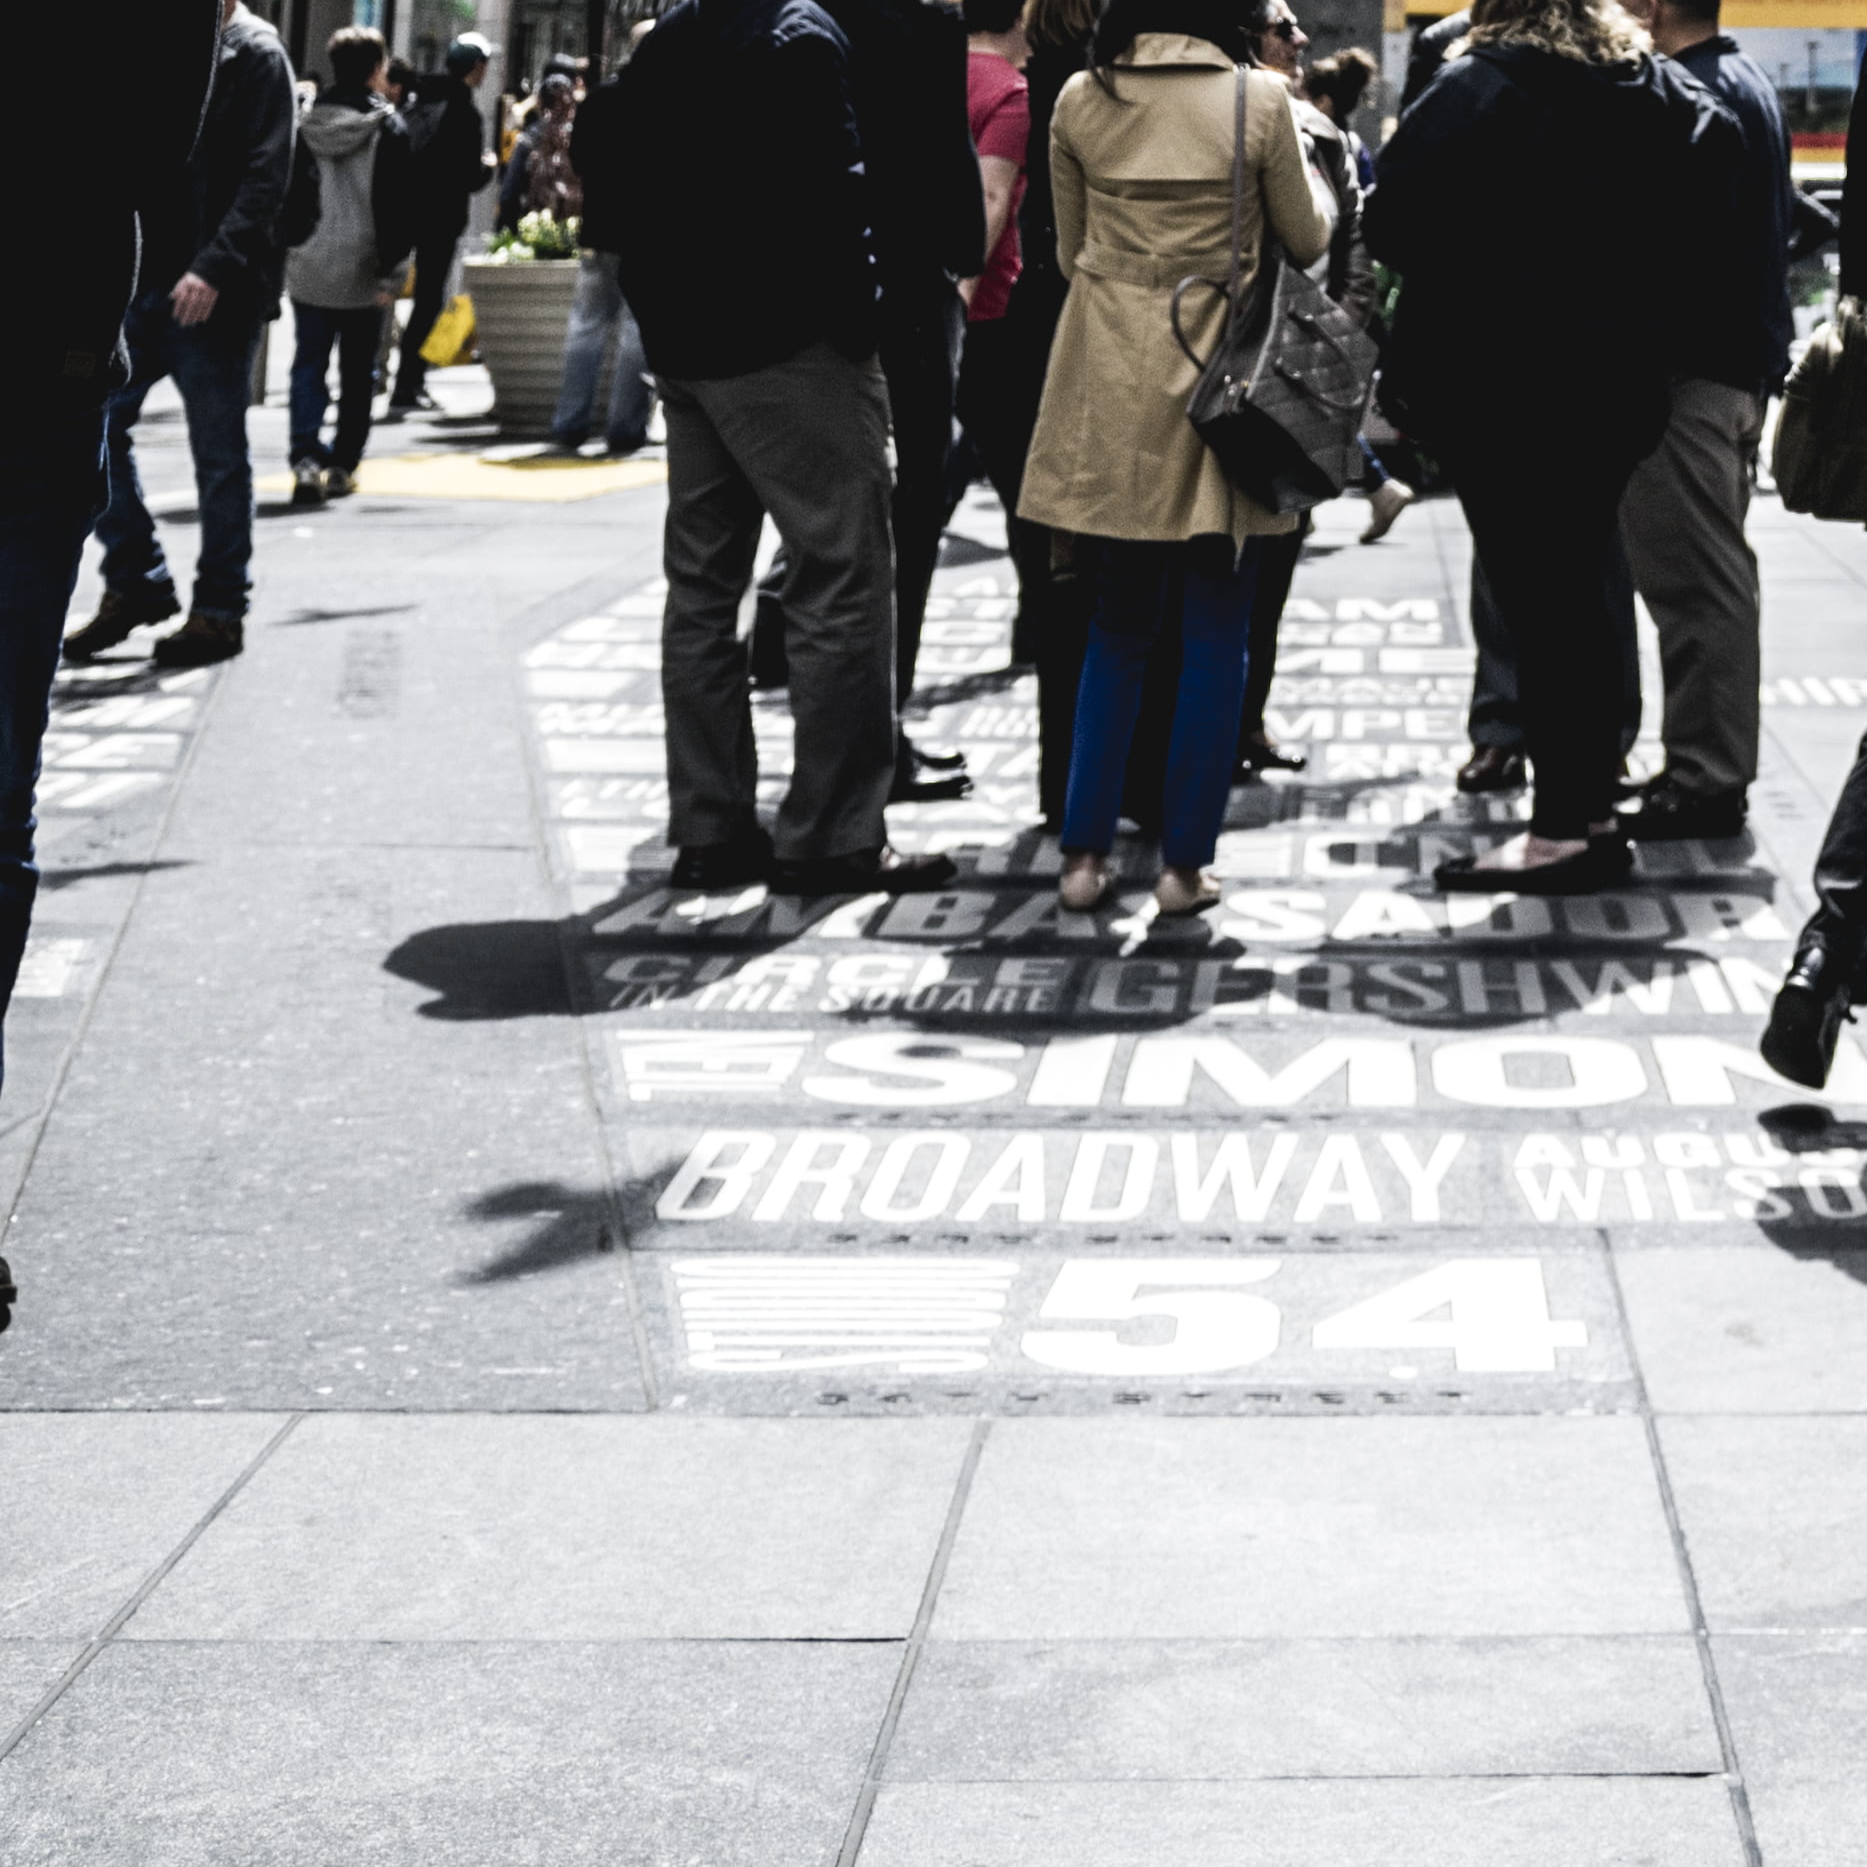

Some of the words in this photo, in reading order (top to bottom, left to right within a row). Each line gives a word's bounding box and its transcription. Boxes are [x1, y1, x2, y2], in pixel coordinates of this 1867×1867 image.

[605, 953, 1068, 987] CIRCLE
[609, 983, 680, 1008] IN
[695, 983, 808, 1013] THE
[817, 982, 1057, 1014] SQUARE
[1087, 956, 1795, 1017] GERSHWIN
[655, 1129, 1467, 1222] BROADWAY
[669, 1256, 1019, 1373] STUDIO
[1019, 1258, 1589, 1375] 54
